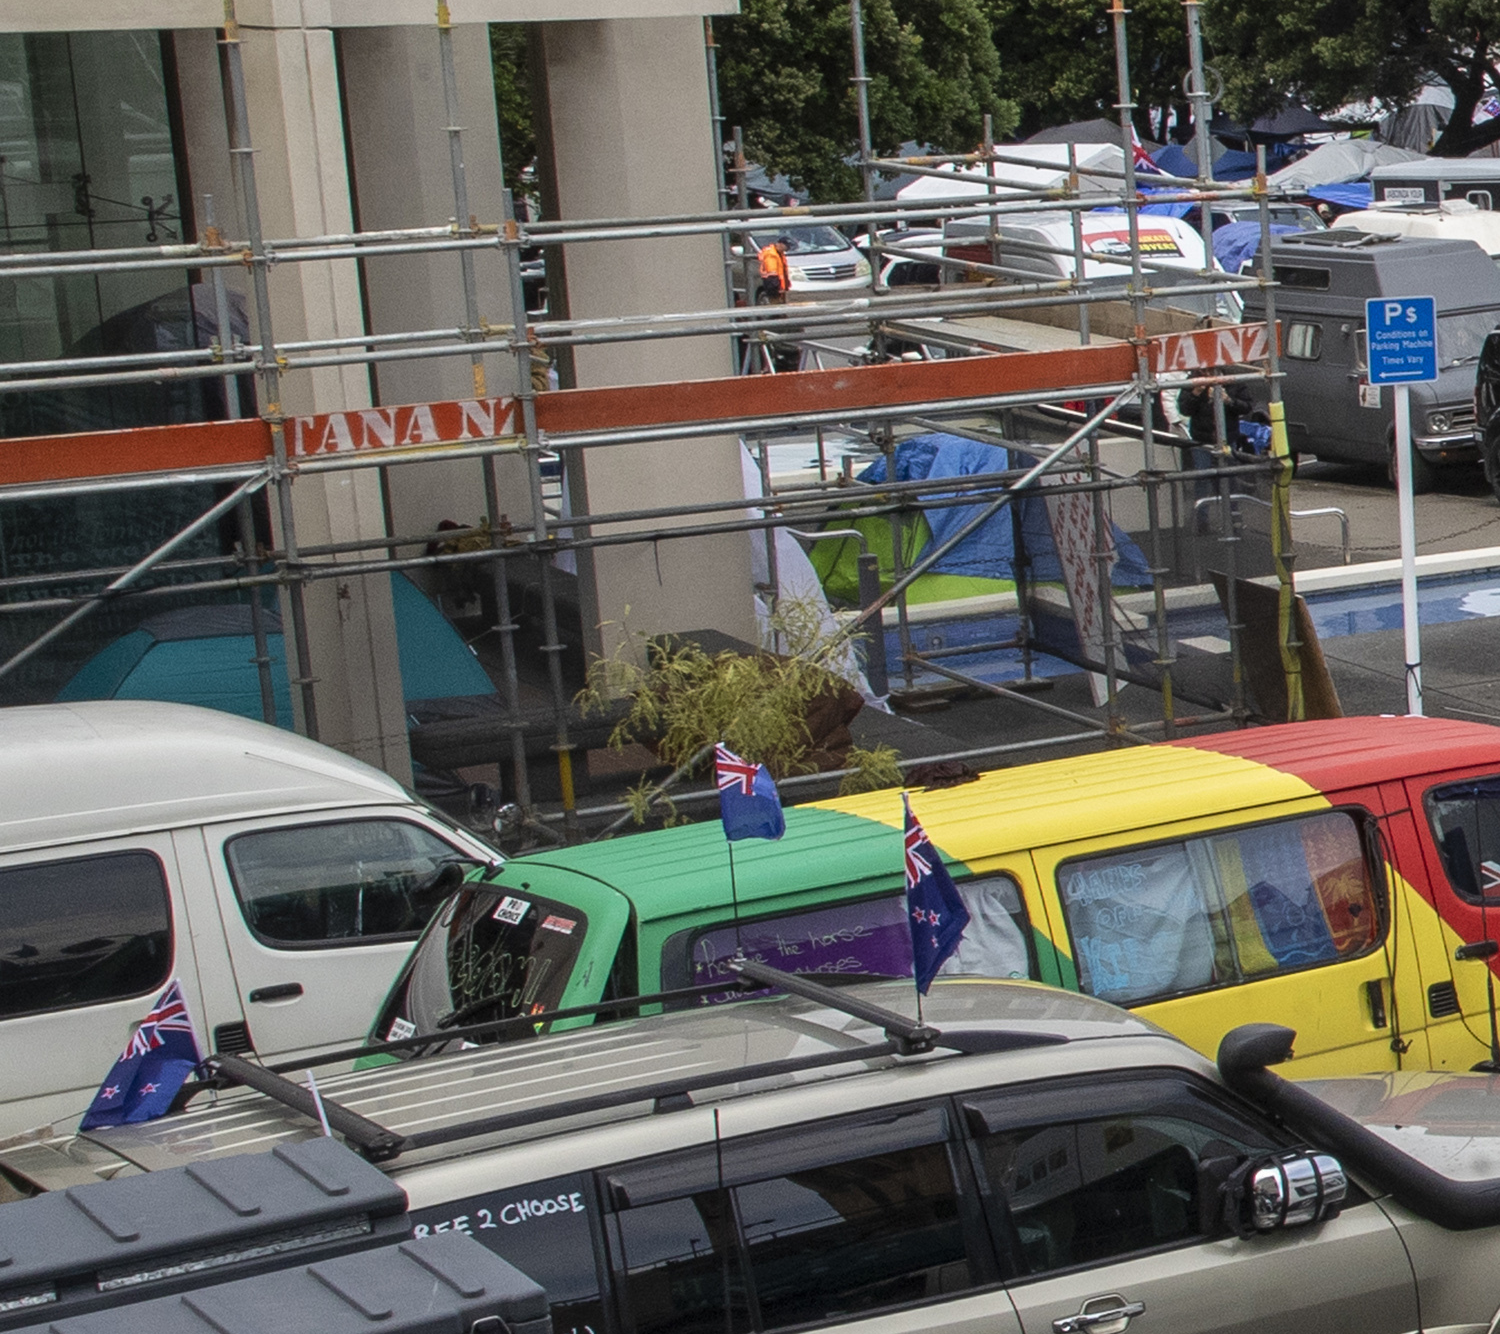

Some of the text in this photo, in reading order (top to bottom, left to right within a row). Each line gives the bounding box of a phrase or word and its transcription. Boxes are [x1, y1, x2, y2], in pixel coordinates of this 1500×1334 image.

[1375, 329, 1428, 341] Conditions on
[1371, 339, 1433, 351] Parking Machine
[1382, 355, 1424, 365] Times Vary
[808, 925, 873, 949] horse
[477, 1208, 497, 1229] 2
[500, 1192, 585, 1224] CHOOSE
